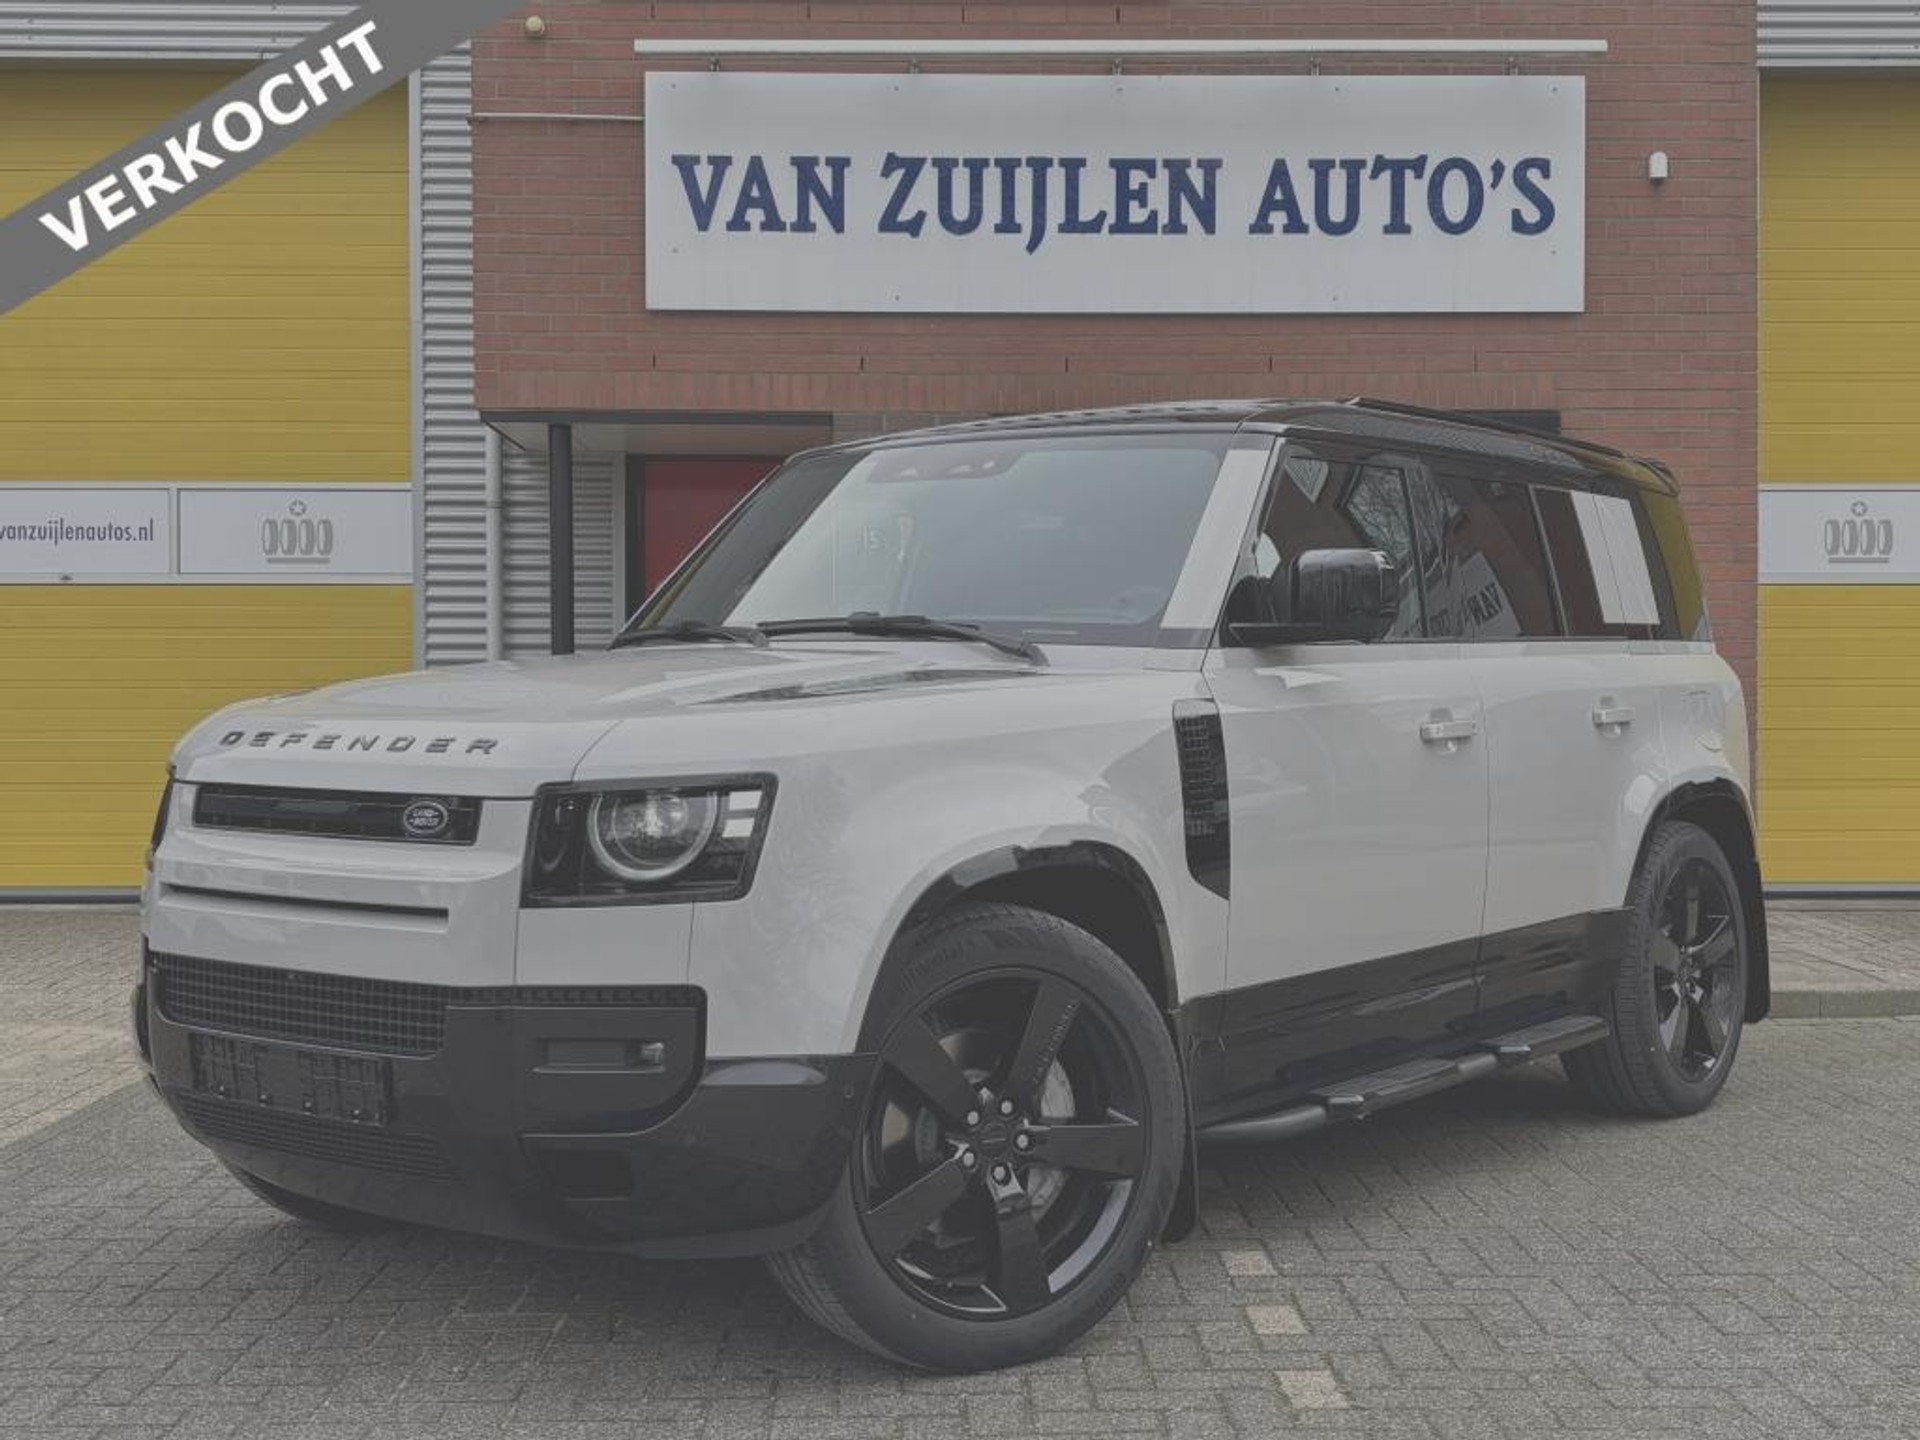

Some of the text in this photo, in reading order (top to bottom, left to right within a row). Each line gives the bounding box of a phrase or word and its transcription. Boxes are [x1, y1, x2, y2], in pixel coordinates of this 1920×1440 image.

[671, 151, 1556, 254] VAN ZUIJLEN AUTO'S
[219, 731, 497, 755] DEFENDER
